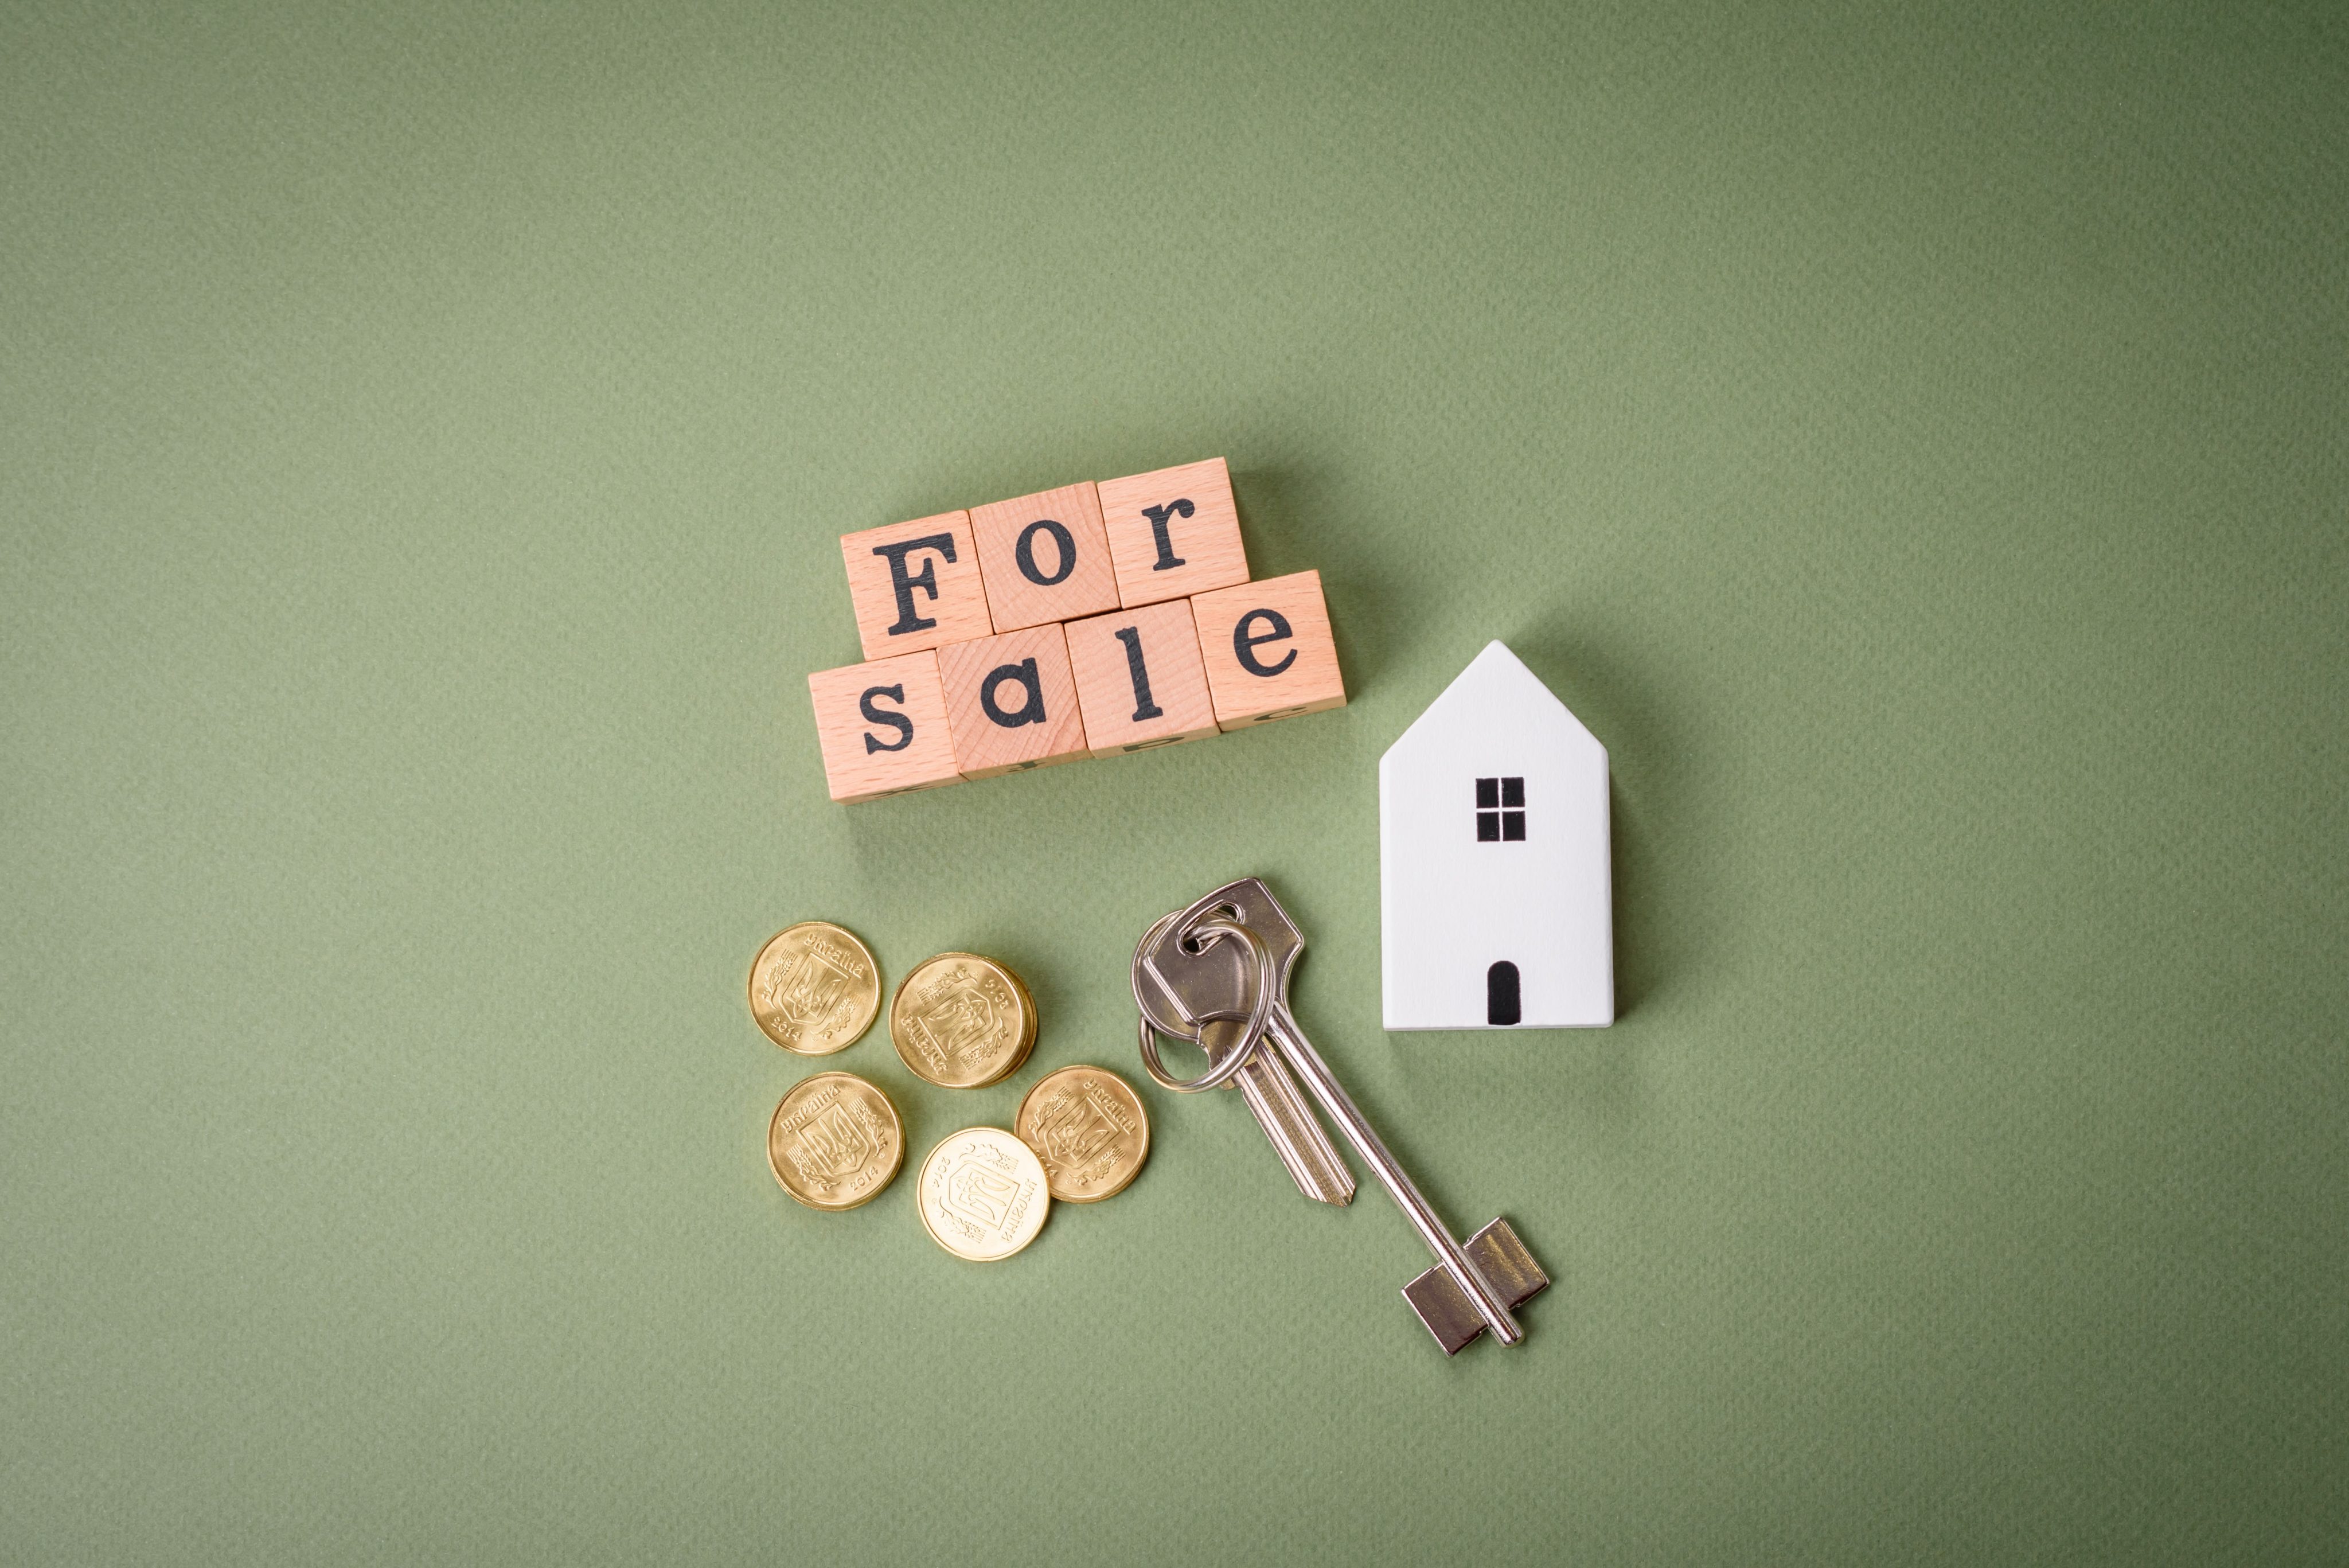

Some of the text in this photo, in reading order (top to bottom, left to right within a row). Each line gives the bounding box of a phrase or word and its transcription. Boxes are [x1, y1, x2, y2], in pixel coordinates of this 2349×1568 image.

[873, 498, 1195, 636] For
[860, 609, 1298, 756] sale
[771, 1016, 802, 1041] 2014
[849, 1165, 879, 1192] 2014
